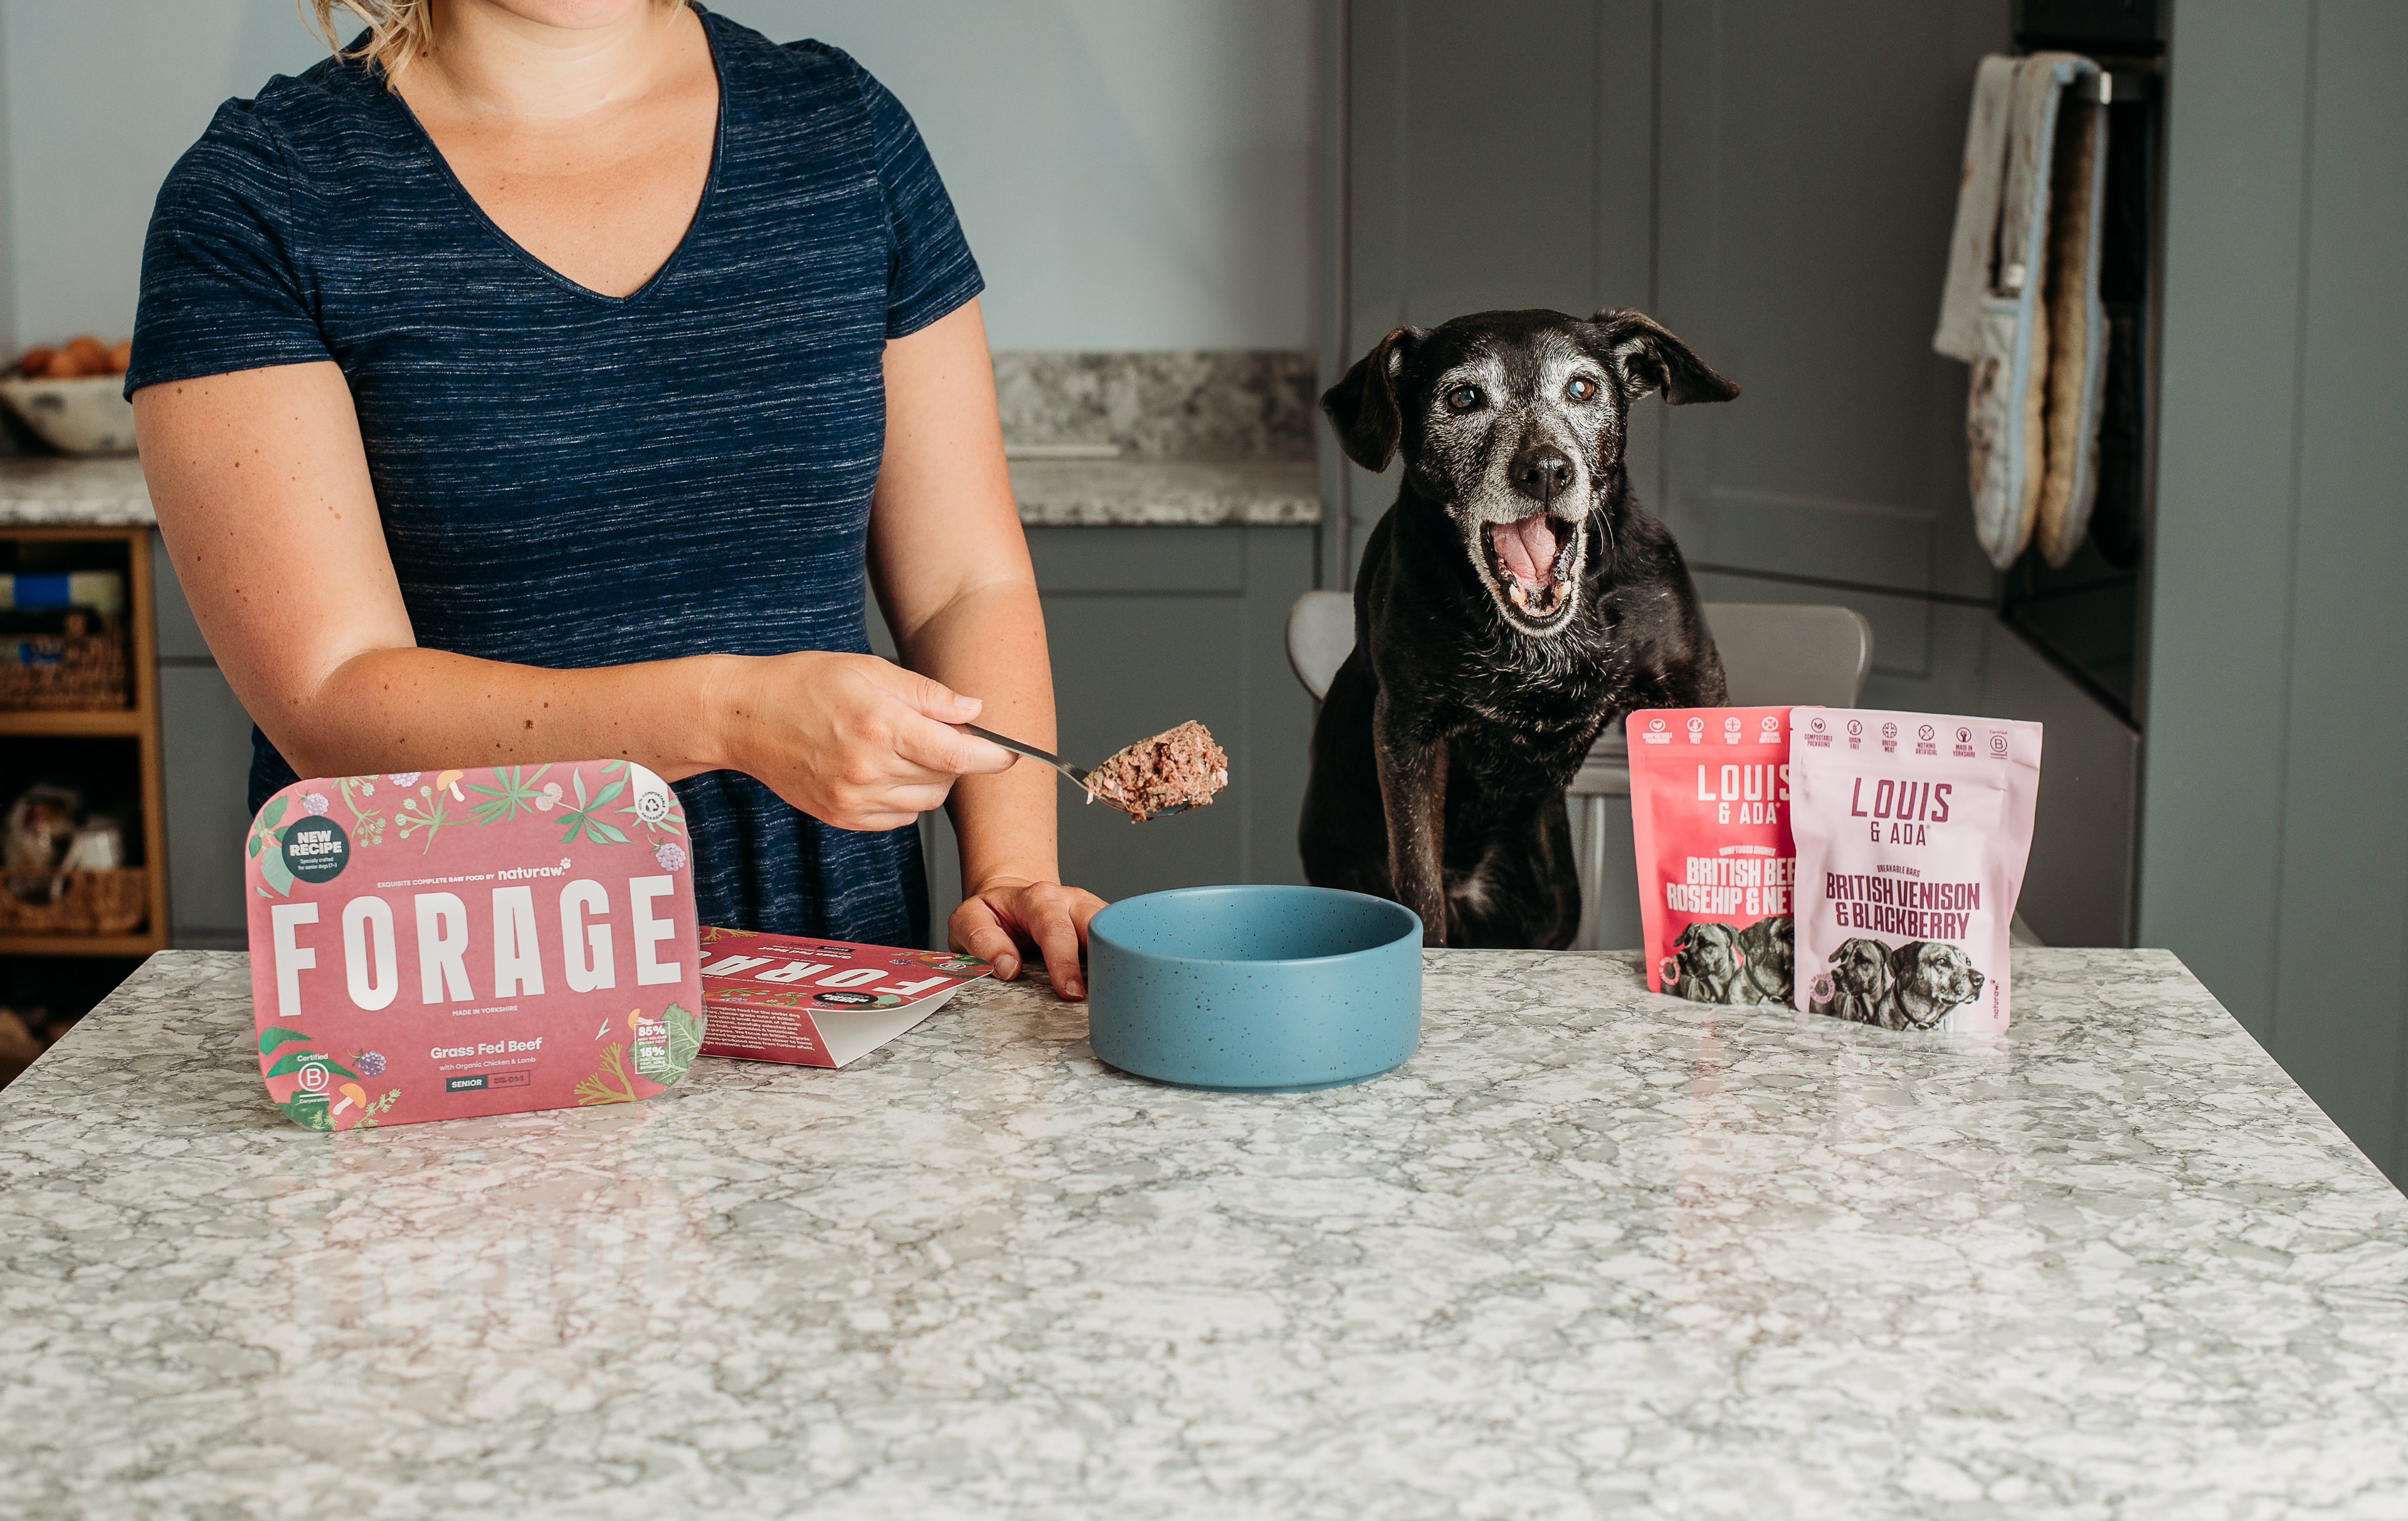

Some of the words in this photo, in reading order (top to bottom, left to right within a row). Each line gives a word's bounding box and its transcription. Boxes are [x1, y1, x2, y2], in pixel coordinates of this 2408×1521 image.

[1804, 734, 1833, 742] COMPOSTABLE
[1851, 777, 1951, 823] LOUIS
[1718, 802, 1731, 824] &
[297, 830, 332, 844] NEW
[1871, 821, 1880, 843] &
[289, 841, 342, 856] RECIPE
[1686, 856, 1761, 887] BRITISH
[1877, 865, 1905, 875] BREAKABLE
[1906, 867, 1921, 878] BARS
[378, 880, 411, 888] EXQUISITE
[412, 877, 447, 886] COMPLETE
[1826, 871, 1894, 905] BRITISH
[1897, 880, 1980, 910] VENISON
[1666, 882, 1743, 915] ROSEHIP
[1746, 887, 1760, 916] &
[1835, 902, 1849, 927] &
[1852, 902, 1970, 940] BLACKBERRY
[271, 875, 682, 1017] FORAGE
[700, 950, 952, 996] FORA
[481, 1005, 518, 1014] YORKSHIRE
[638, 1025, 666, 1036] 85%
[430, 1046, 475, 1059] Grass
[478, 1040, 505, 1055] Fed
[508, 1036, 542, 1052] Beef
[640, 1046, 665, 1057] 15%
[297, 1053, 329, 1062] Certified
[455, 1061, 482, 1070] Organic
[483, 1058, 510, 1067] Chicken
[306, 1068, 322, 1087] B
[451, 1079, 482, 1088] SENIOR
